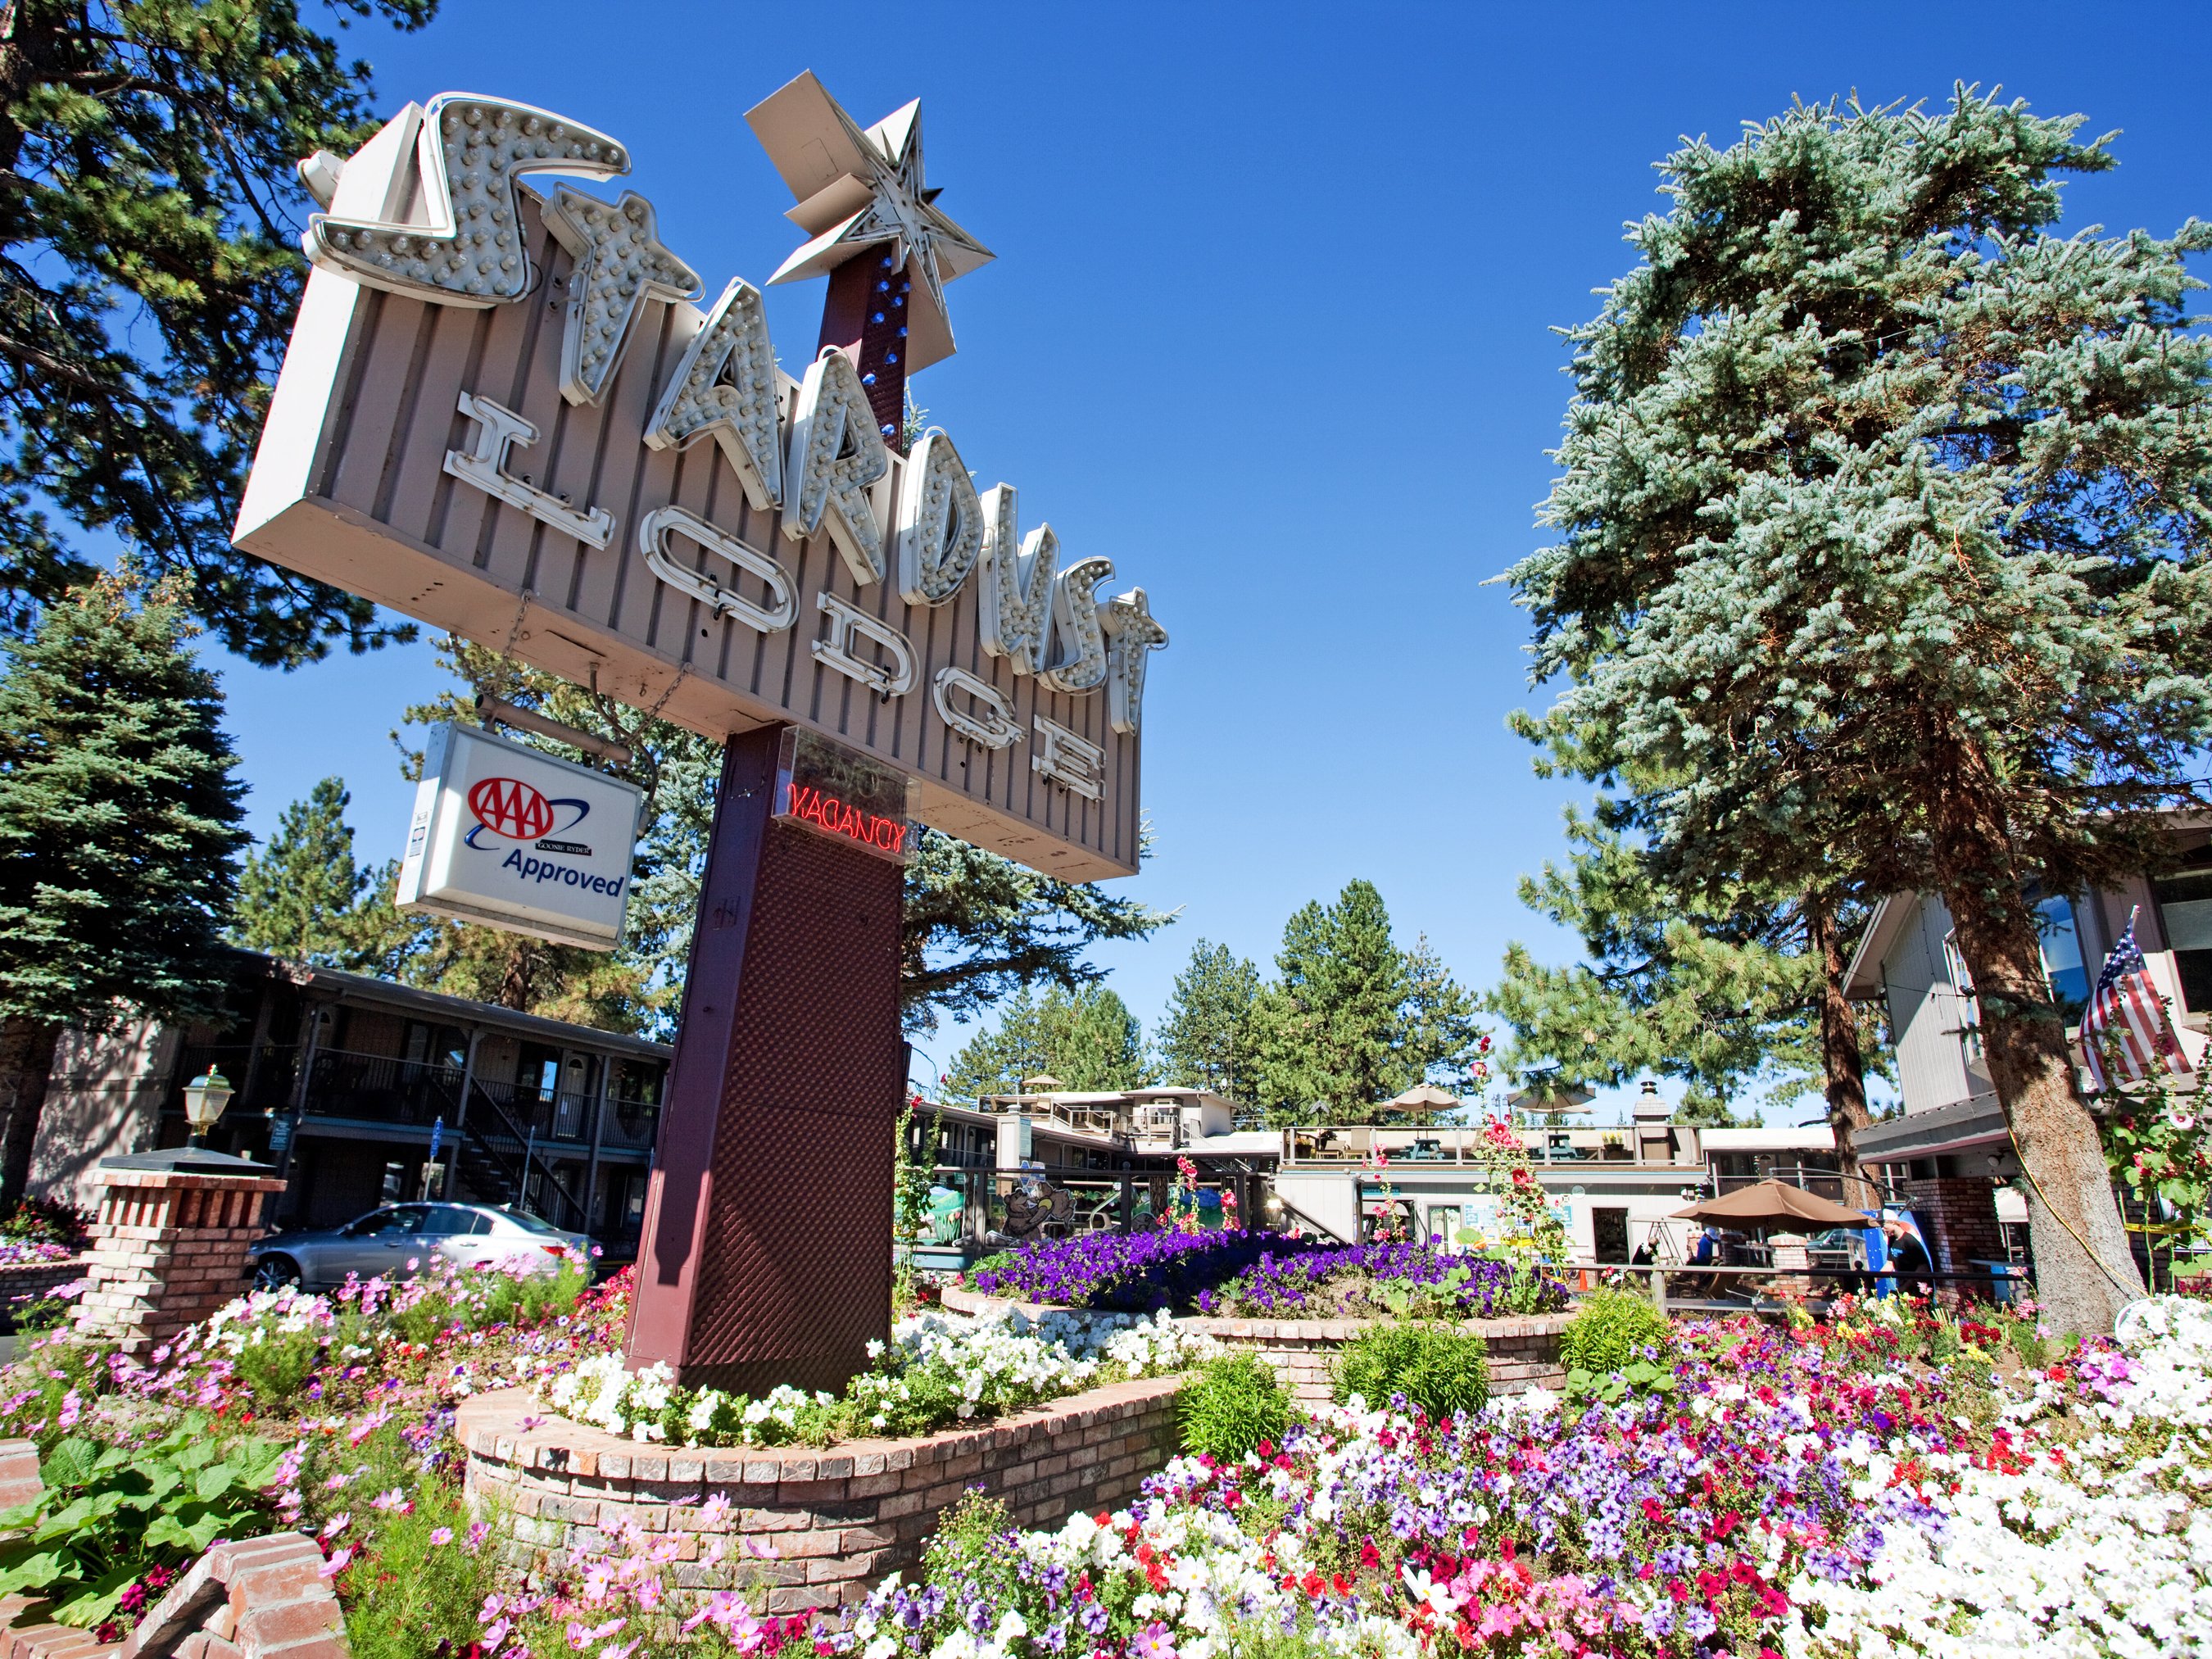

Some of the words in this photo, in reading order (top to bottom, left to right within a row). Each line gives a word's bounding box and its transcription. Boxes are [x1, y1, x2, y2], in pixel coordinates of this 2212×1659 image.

[303, 92, 1170, 735] STARDUST
[443, 391, 1106, 802] LODGE
[470, 778, 551, 839] AAA
[787, 783, 907, 854] VACANCY
[501, 848, 625, 898] Approved
[537, 842, 565, 851] GOONIE
[566, 845, 589, 854] RYDER
